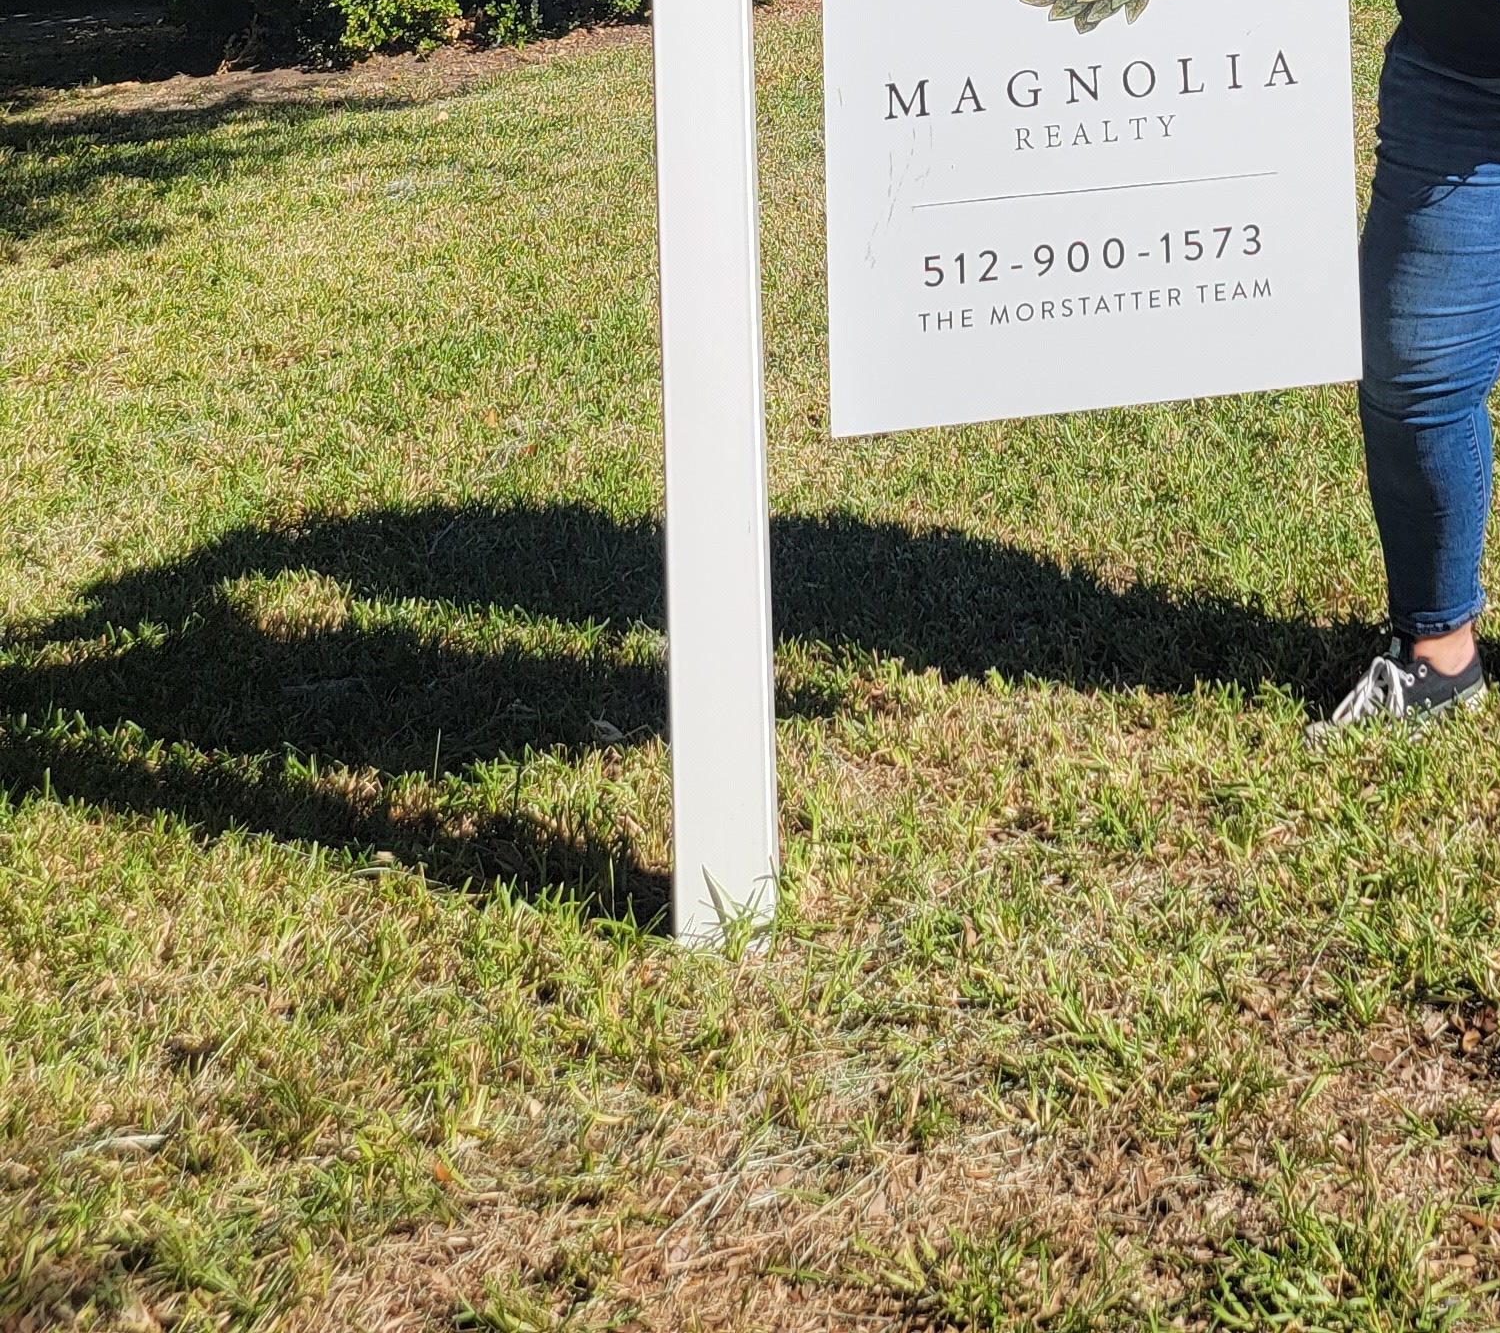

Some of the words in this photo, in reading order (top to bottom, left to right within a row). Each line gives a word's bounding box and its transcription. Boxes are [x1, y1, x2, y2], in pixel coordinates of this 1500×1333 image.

[884, 50, 1298, 120] MAGNOLIA
[1014, 114, 1177, 151] REALTY
[924, 224, 1263, 288] 512-900-1573
[918, 308, 974, 333] THE
[989, 287, 1182, 326] MORSTATTER
[1195, 278, 1273, 304] TEAM
